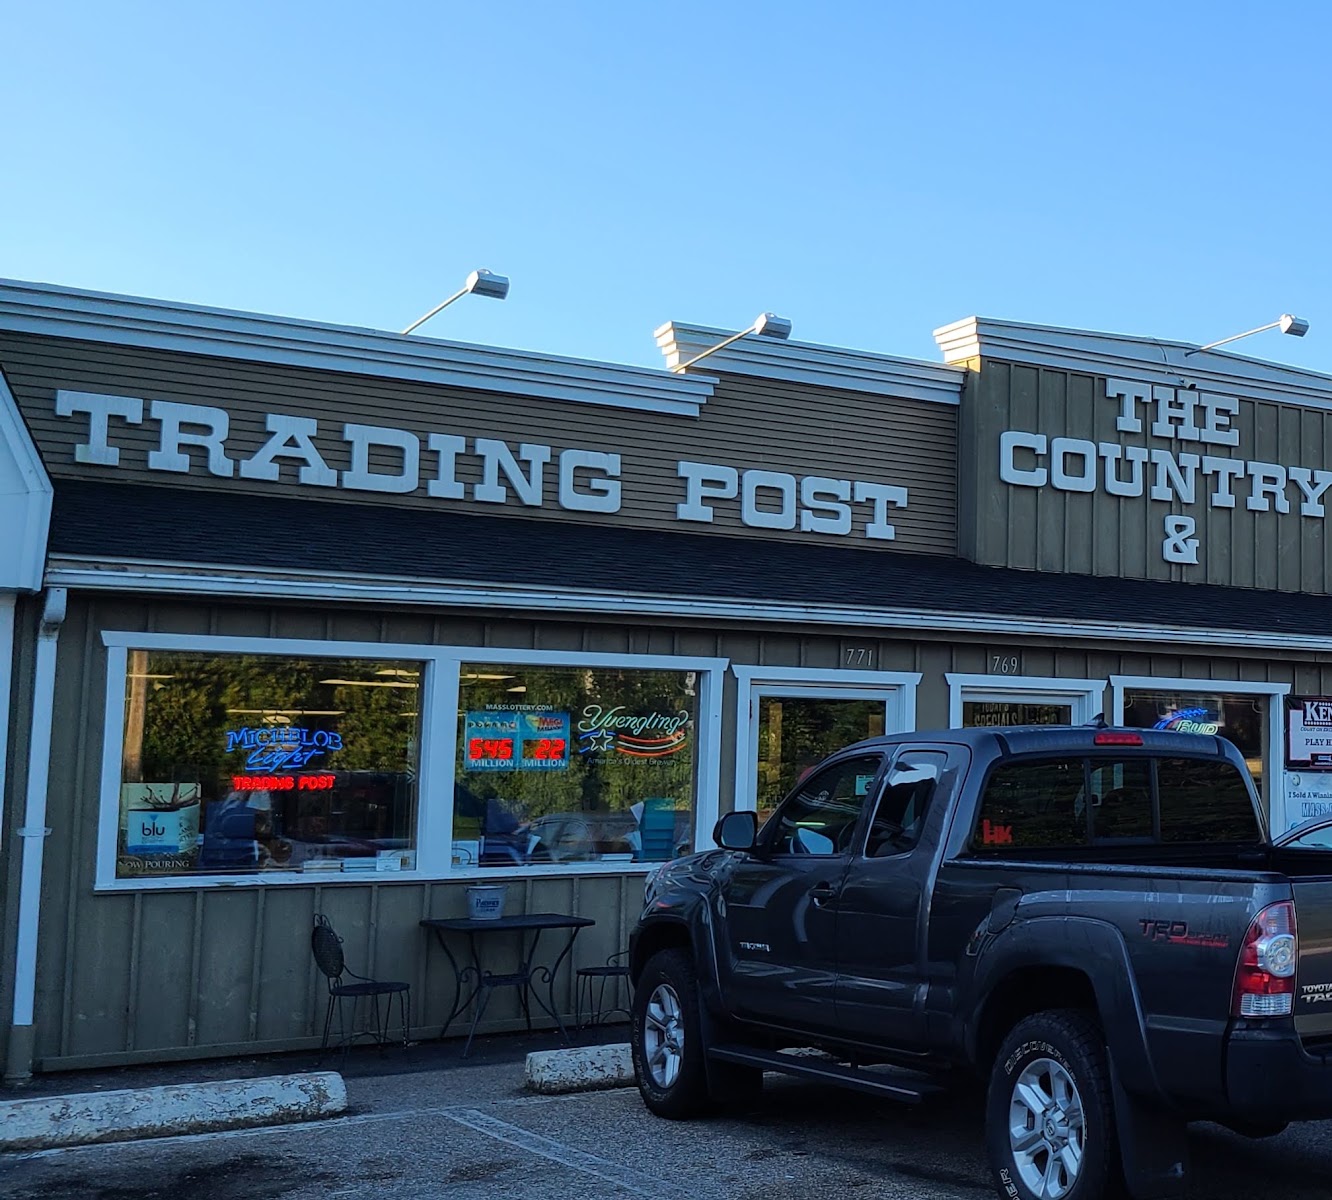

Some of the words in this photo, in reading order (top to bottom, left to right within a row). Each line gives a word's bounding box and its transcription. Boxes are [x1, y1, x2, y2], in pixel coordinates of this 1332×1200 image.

[1106, 378, 1240, 446] THE
[55, 389, 622, 514] TRADING
[677, 461, 908, 540] POST
[1163, 515, 1200, 565] &
[846, 649, 872, 666] 771
[992, 656, 1018, 673] 769
[485, 703, 553, 711] MASSLOTTERY.COM
[578, 704, 689, 735] Yuengling
[1176, 720, 1219, 735] BUD
[225, 727, 344, 752] MICHELOB
[1305, 738, 1325, 746] PLAY
[469, 738, 513, 760] 545
[535, 738, 566, 760] 22
[471, 760, 514, 768] MILLION
[524, 760, 566, 768] MILLION
[232, 774, 295, 791] TRADING
[298, 774, 336, 791] POST
[1292, 791, 1306, 799] Sold
[142, 822, 166, 837] blu
[144, 860, 190, 869] POURING
[1139, 919, 1188, 941] TRD
